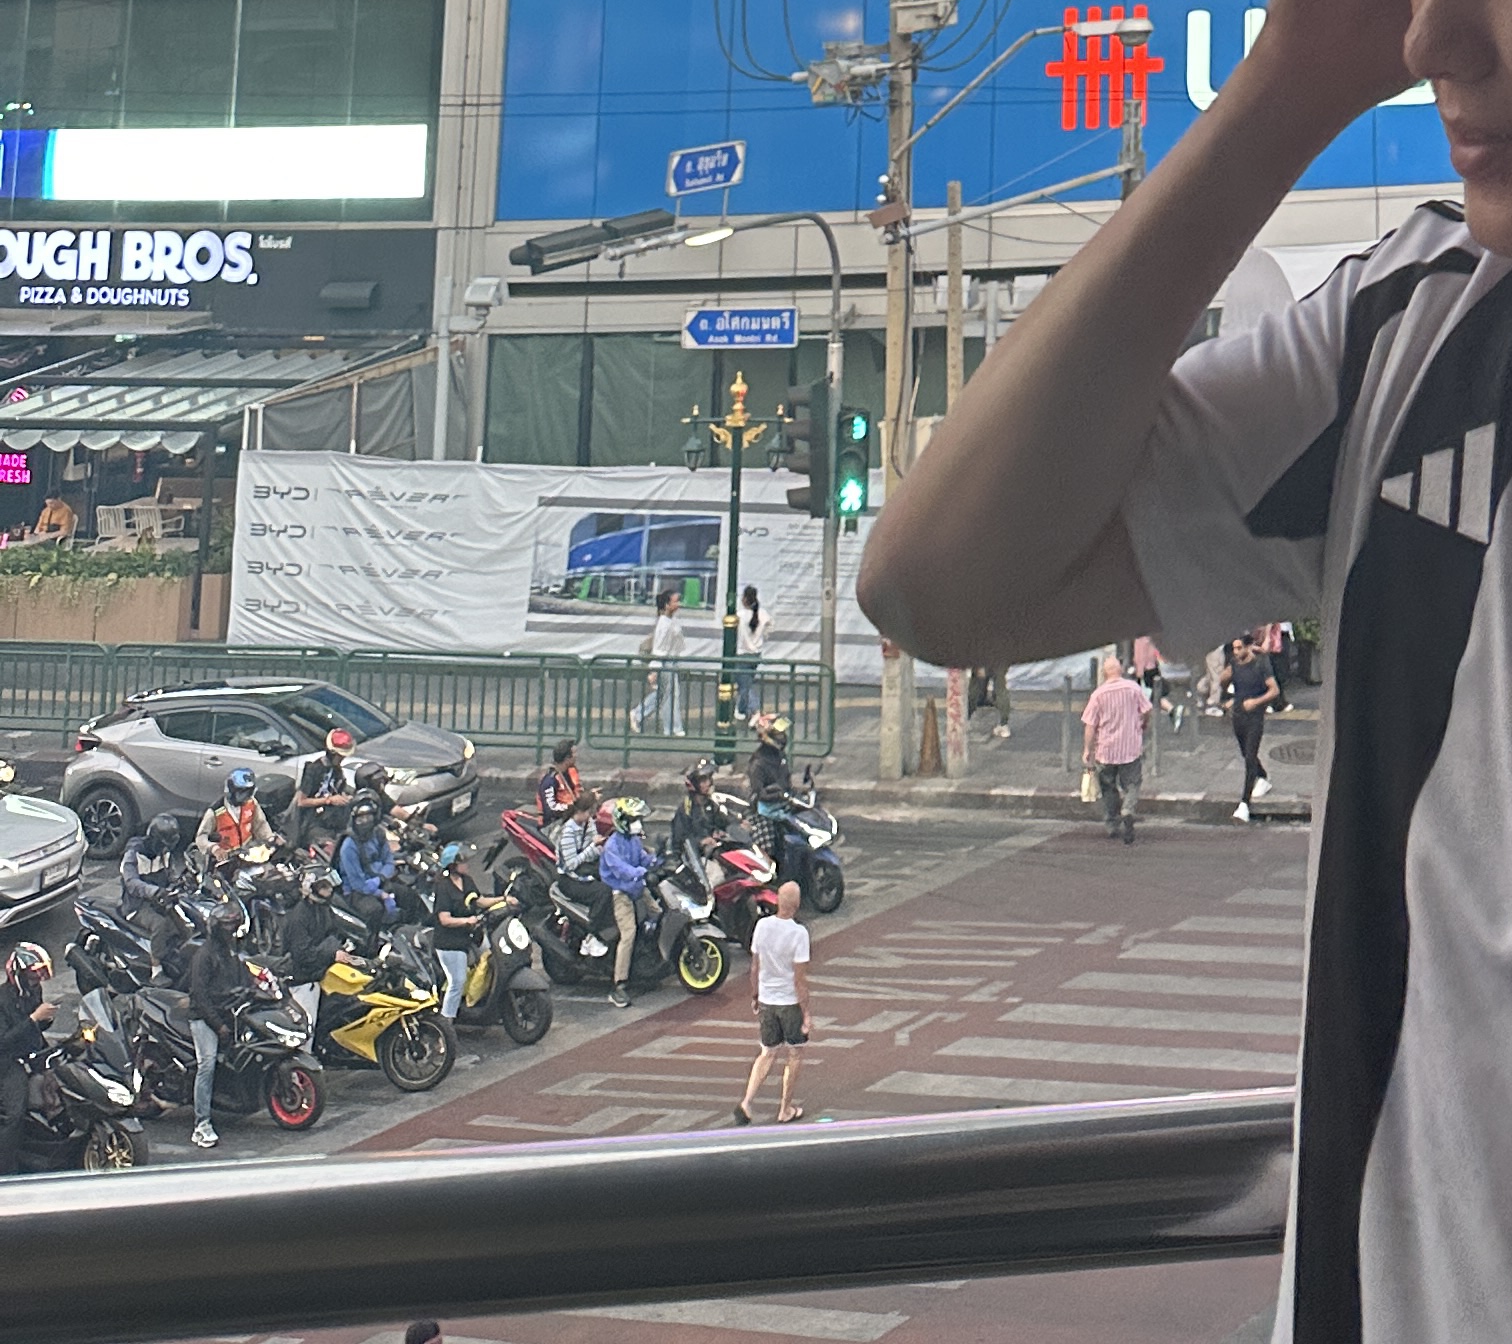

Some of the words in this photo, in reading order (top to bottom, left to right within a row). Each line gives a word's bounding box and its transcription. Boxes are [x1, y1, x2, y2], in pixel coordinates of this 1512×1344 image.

[121, 231, 258, 284] BROS.
[20, 287, 66, 304] PIZZA
[71, 287, 82, 304] &
[87, 287, 190, 306] DOUGHNUTS
[716, 310, 790, 331] อโศกมนตรี
[254, 486, 310, 500] BYD
[250, 523, 307, 539] BYD
[247, 561, 303, 576] BYD
[245, 598, 301, 613] BYD
